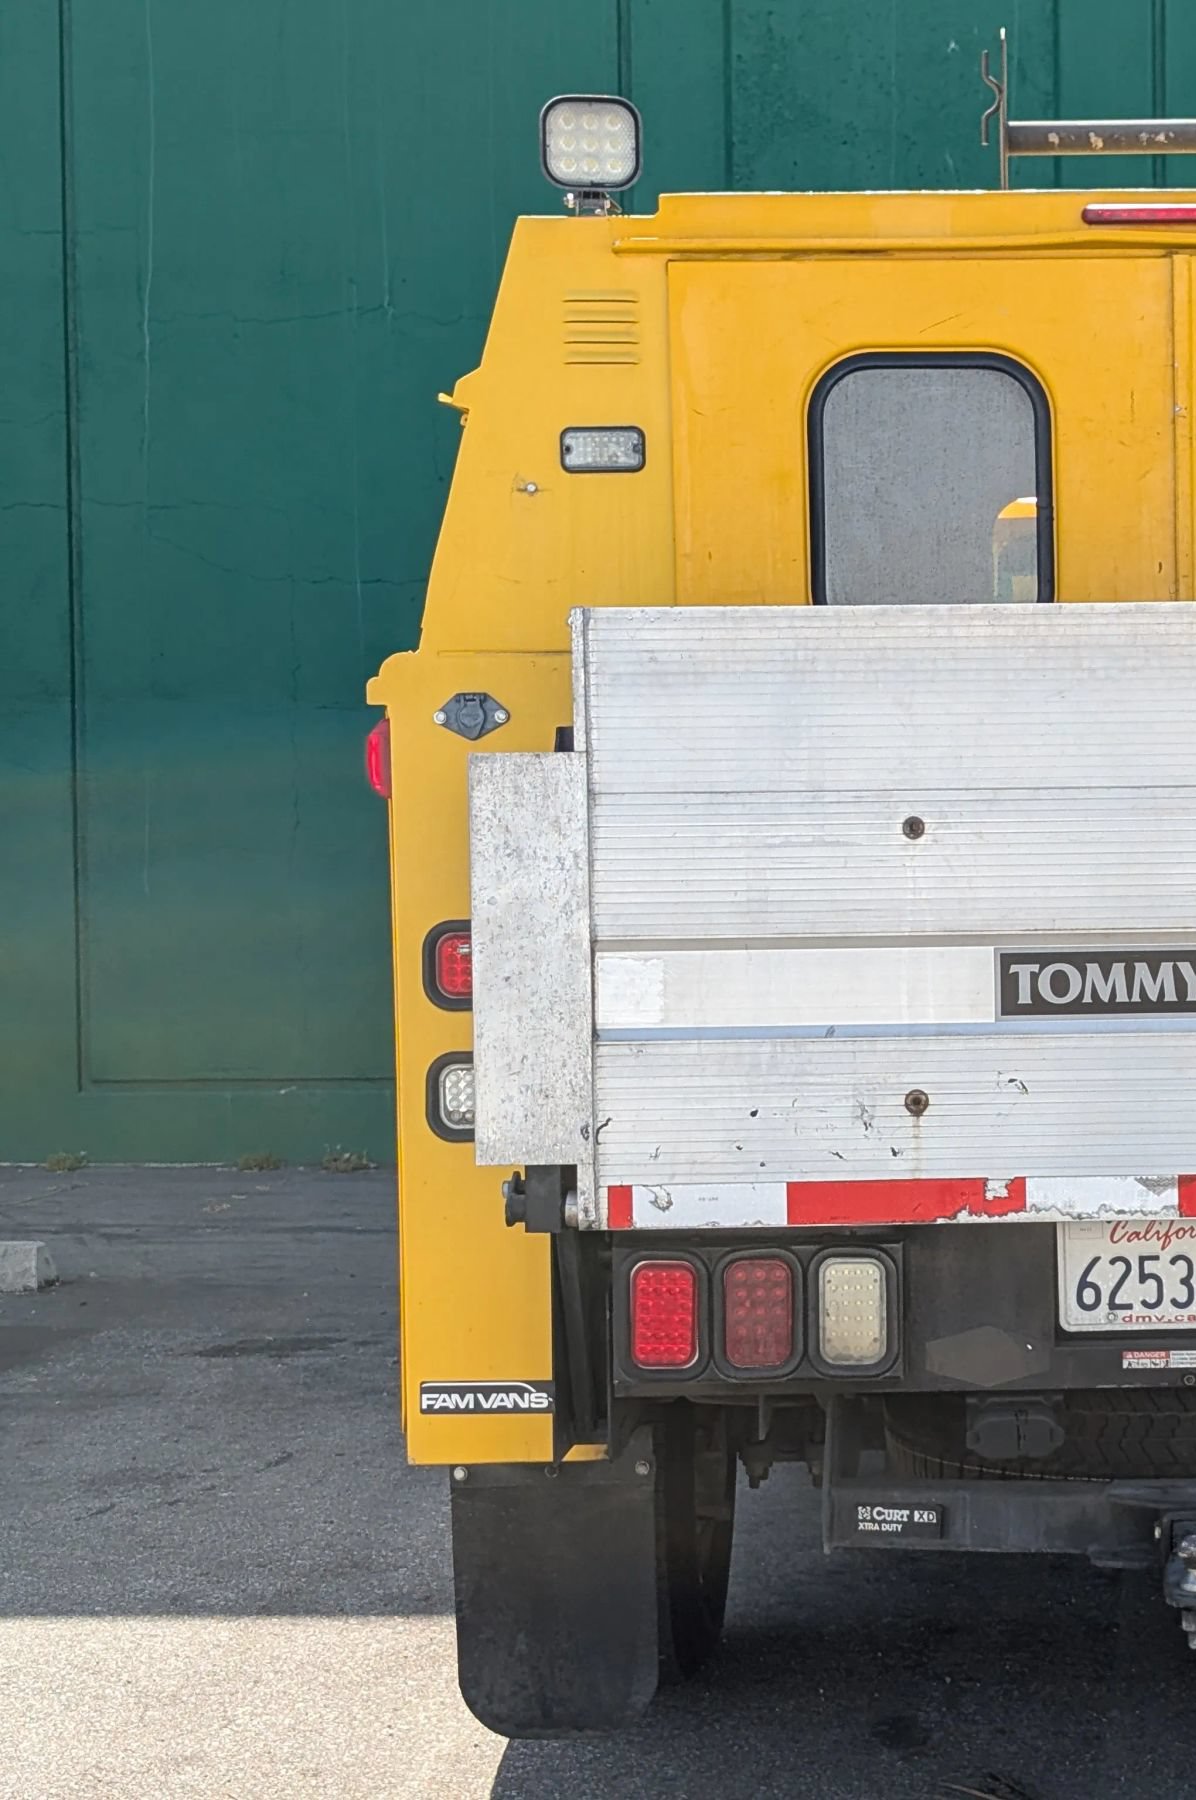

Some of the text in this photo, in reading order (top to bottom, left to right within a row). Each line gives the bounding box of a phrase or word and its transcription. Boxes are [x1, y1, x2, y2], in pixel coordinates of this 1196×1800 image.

[1133, 1351, 1166, 1359] DANGER
[421, 1392, 549, 1410] FAM VANS
[914, 1510, 937, 1523] XD
[858, 1522, 903, 1532] XTRA DUTY
